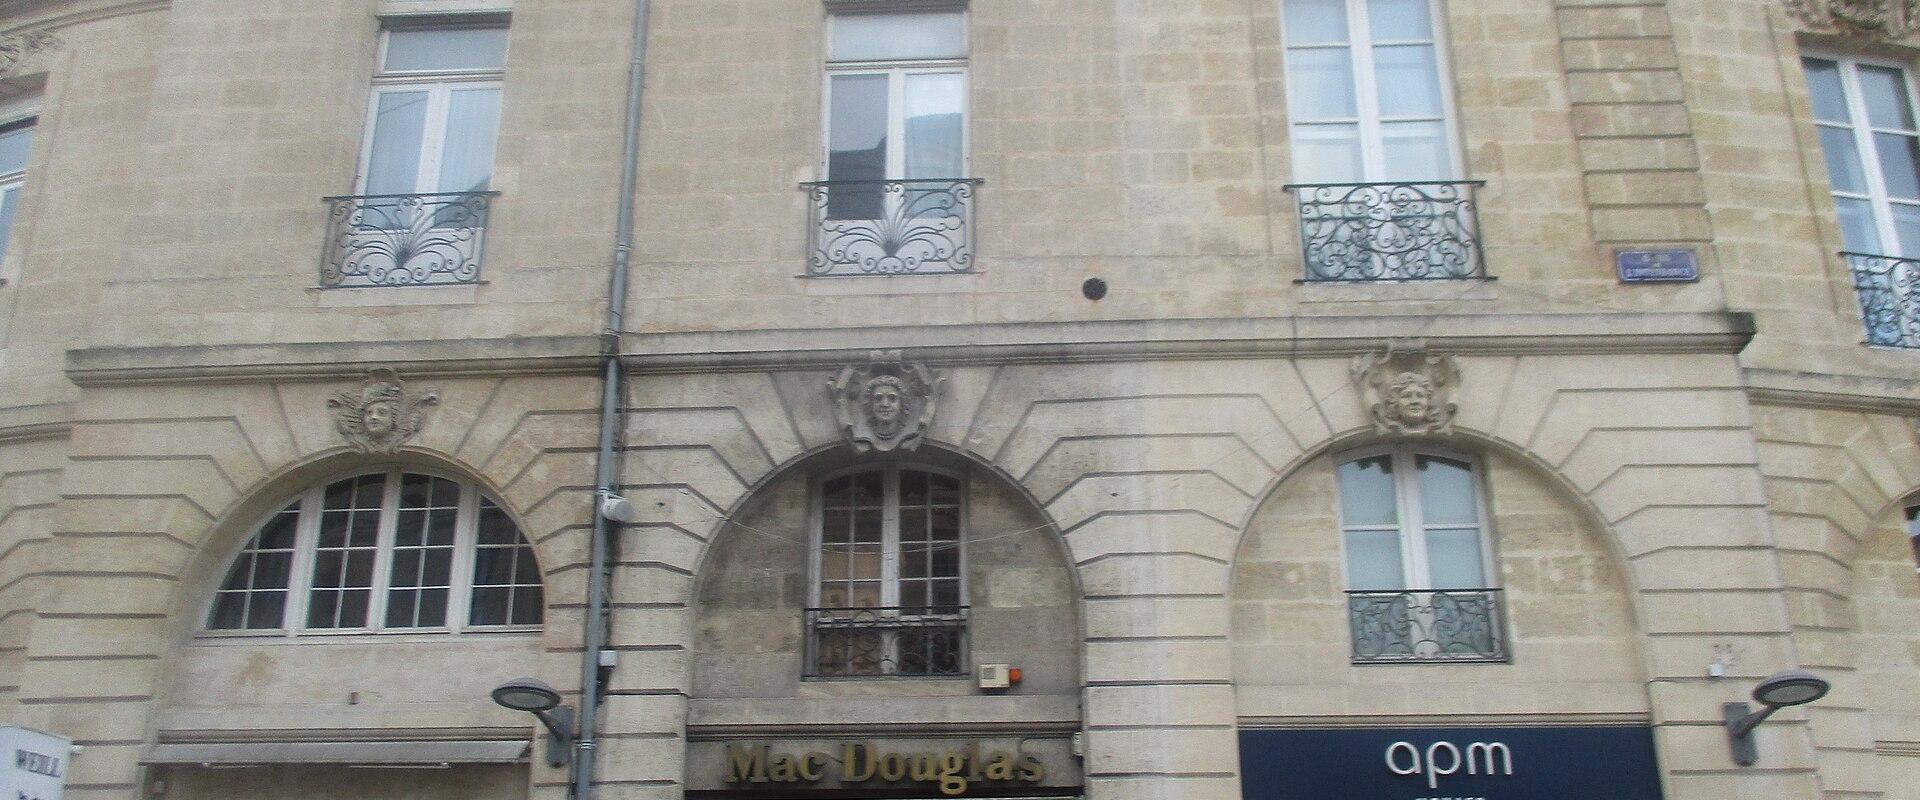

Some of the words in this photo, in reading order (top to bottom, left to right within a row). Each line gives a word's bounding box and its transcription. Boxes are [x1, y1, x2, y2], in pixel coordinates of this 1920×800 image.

[725, 743, 827, 784] Mac
[841, 740, 1046, 796] Douglas
[1385, 741, 1513, 789] apm
